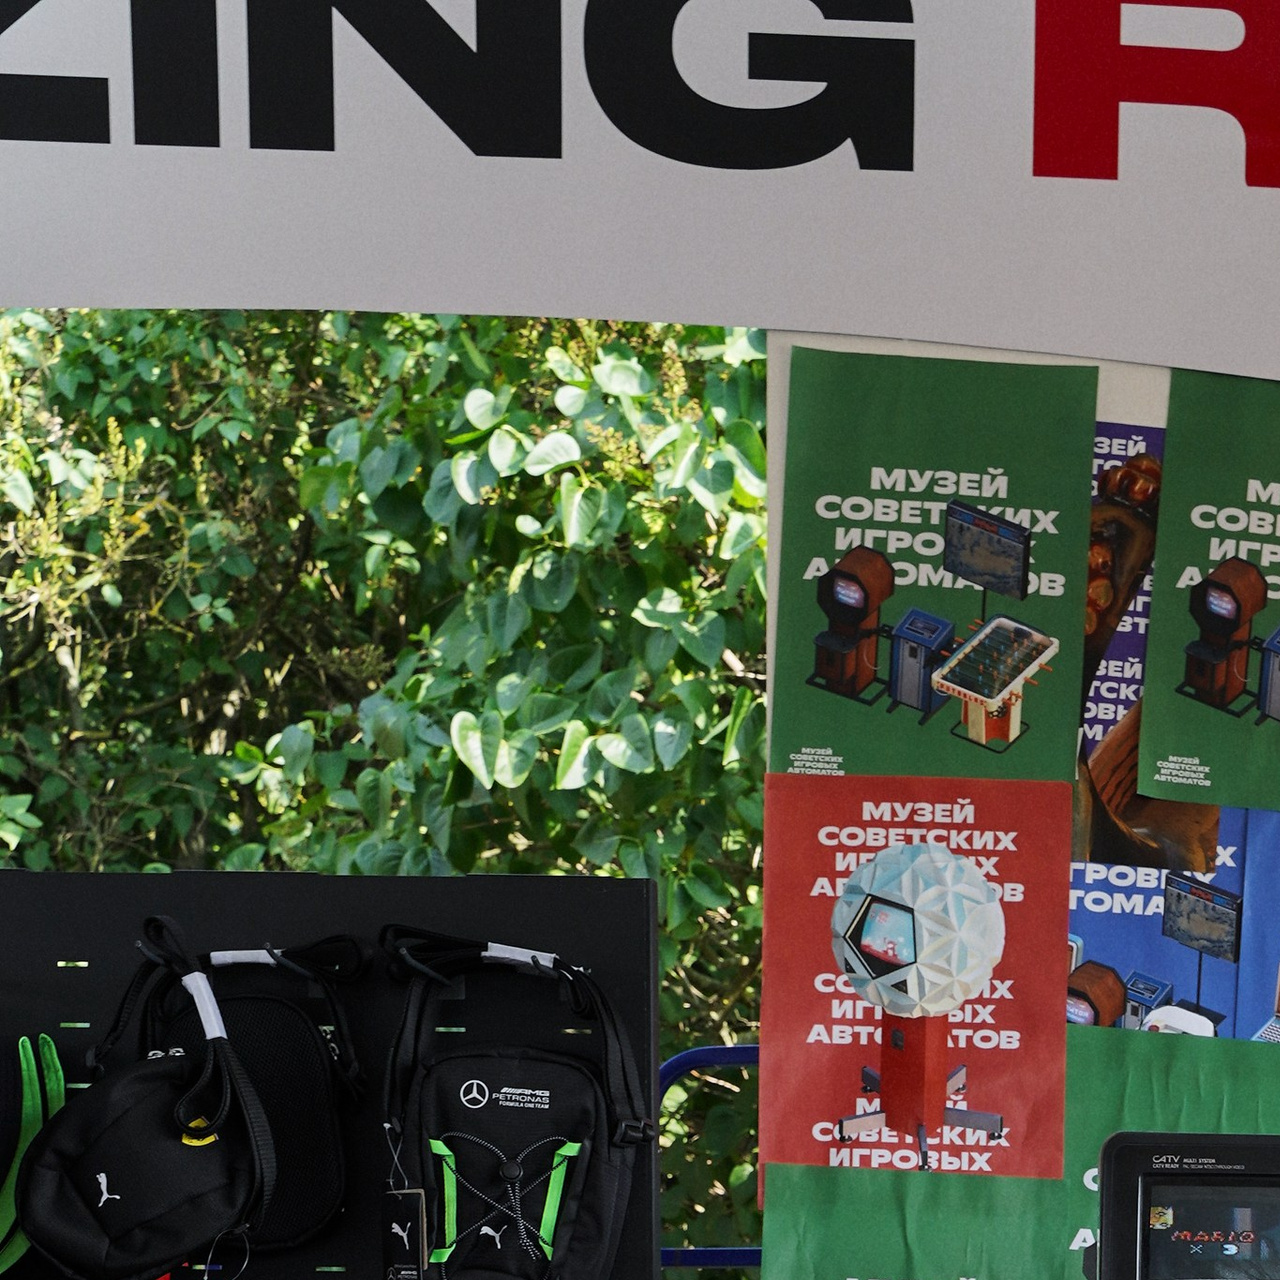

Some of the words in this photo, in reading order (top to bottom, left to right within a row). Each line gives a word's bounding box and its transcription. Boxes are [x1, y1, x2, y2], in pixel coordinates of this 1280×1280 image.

[1093, 436, 1146, 456] ЗЕЙ
[871, 467, 1008, 498] МУЗЕЙ
[835, 527, 1036, 564] ИГРО
[1096, 658, 1142, 680] ЗЕЙ
[862, 798, 975, 824] МУЗЕЙ
[817, 826, 1019, 851] СОВЕТСКИХ
[492, 1092, 550, 1104] PETRONAS
[1152, 1155, 1180, 1163] CATV
